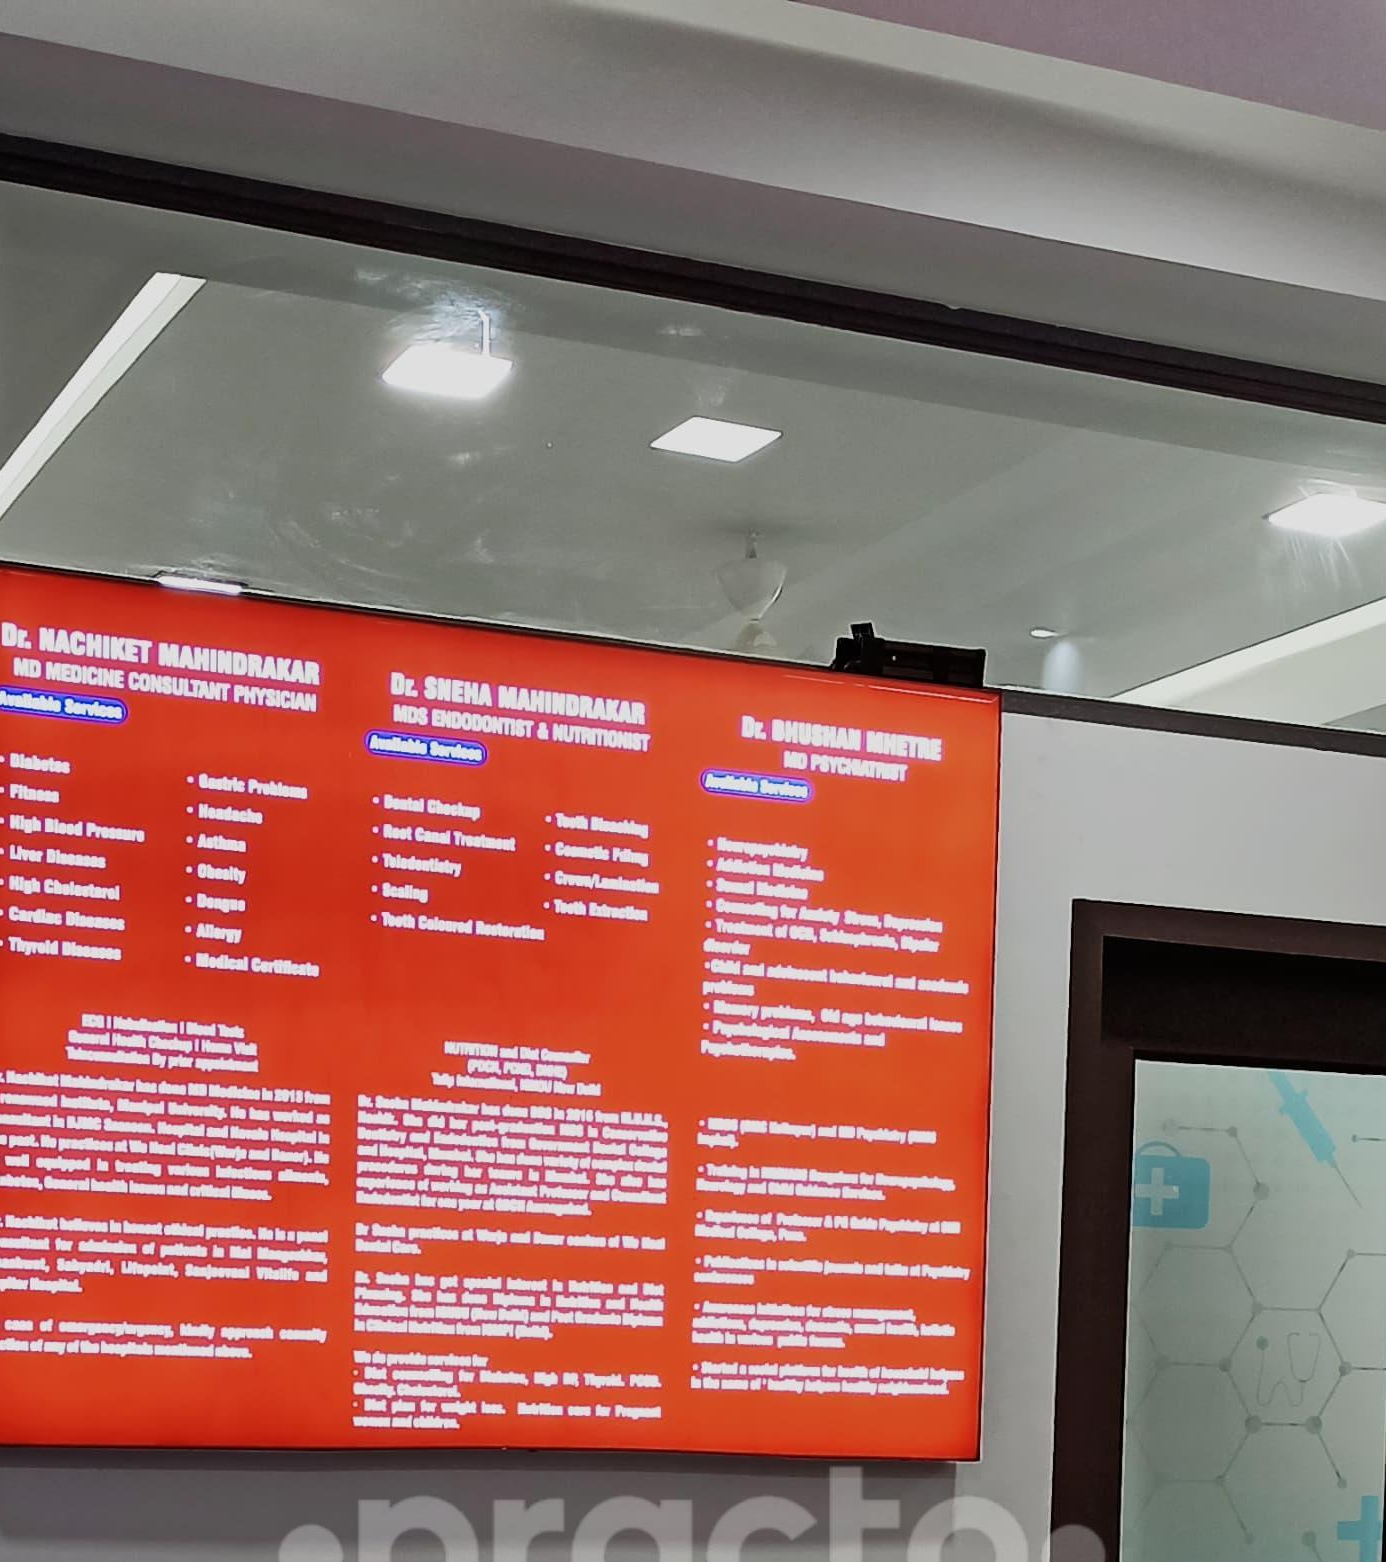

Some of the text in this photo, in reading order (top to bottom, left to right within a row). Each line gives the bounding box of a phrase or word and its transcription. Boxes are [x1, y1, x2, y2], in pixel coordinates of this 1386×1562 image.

[2, 622, 319, 685] Dr. NACHIKET MAHINDRAKAR
[14, 658, 316, 712] MD MEDICINE CONSULTANT PHYSICIAN
[391, 672, 645, 725] Dr. SNEHA MAHINDRAKAR
[65, 699, 122, 719] Services
[394, 704, 650, 751] MDS ENDODONTIST & NUTRITIONIST
[370, 735, 427, 754] Available
[742, 716, 766, 740] Dr.
[772, 719, 861, 751] BHUSHAN
